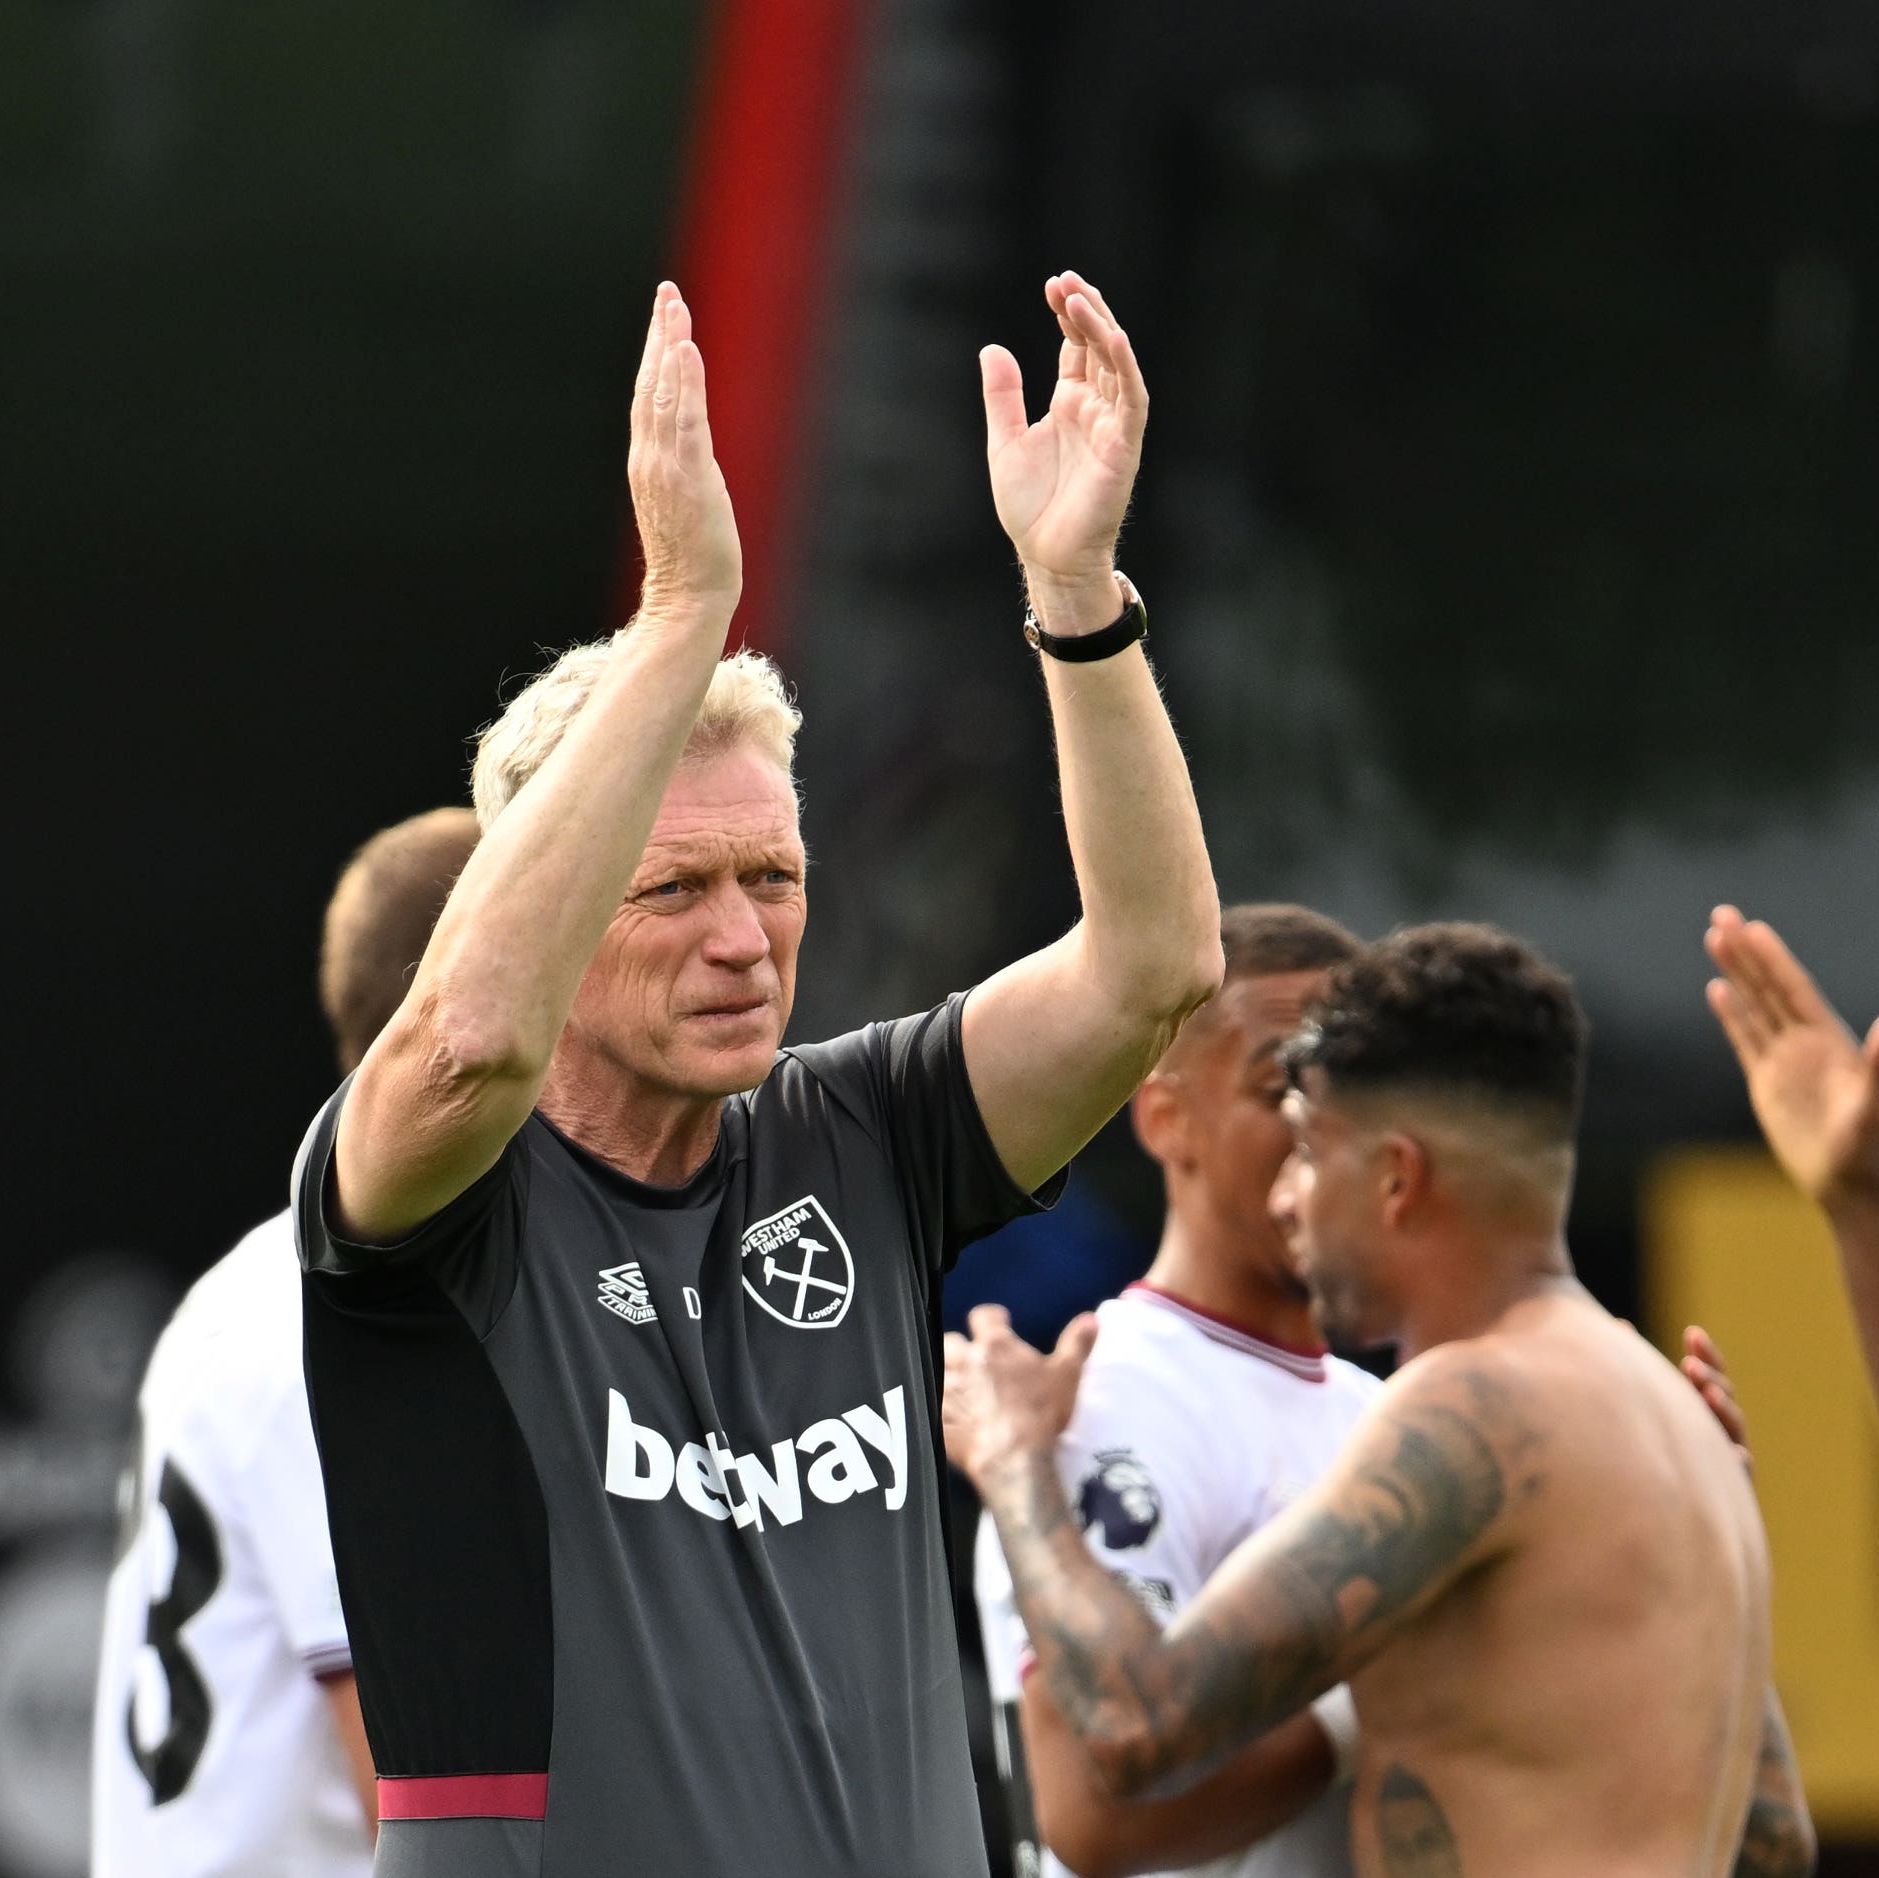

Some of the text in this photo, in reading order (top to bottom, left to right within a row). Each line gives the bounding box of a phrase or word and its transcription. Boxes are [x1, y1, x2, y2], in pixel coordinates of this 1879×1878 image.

[741, 1207, 813, 1258] WEST HAM
[758, 1227, 801, 1256] UNITED
[807, 1297, 843, 1321] LONDON
[604, 1383, 909, 1534] betway
